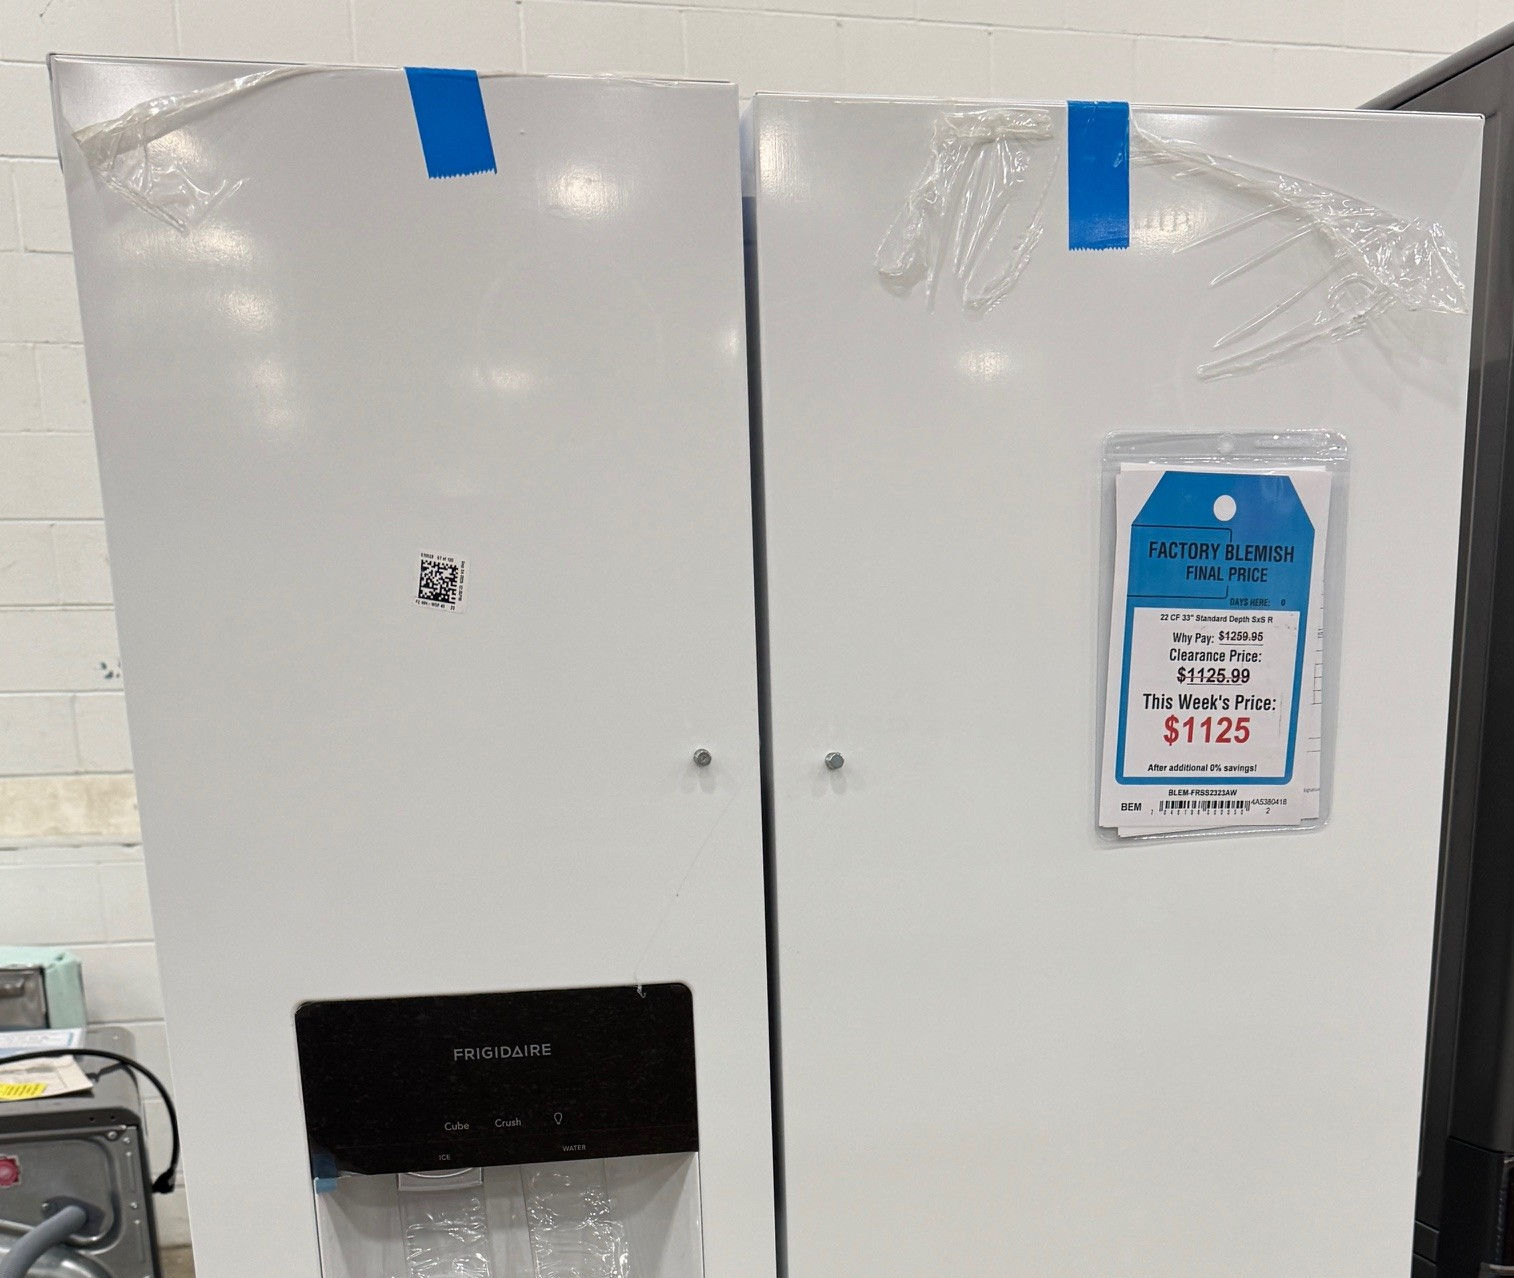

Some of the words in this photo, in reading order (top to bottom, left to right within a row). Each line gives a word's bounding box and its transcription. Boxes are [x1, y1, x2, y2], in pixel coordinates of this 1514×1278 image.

[1149, 541, 1220, 561] FACTORY
[1225, 544, 1294, 562] BLEMISH
[1186, 566, 1224, 581] FINAL
[1228, 567, 1268, 582] PRICE
[1230, 598, 1248, 606] DAYS
[1196, 614, 1227, 623] Standard
[1229, 615, 1249, 624] Depth
[1173, 632, 1192, 644] Why
[1195, 633, 1214, 645] Pay:
[1219, 631, 1263, 642] $1259.95
[1169, 648, 1225, 662] Clearance
[1230, 650, 1262, 662] Price:
[1177, 666, 1250, 684] $1125.99
[1143, 693, 1172, 709] This
[1179, 694, 1230, 710] Week's
[1234, 695, 1276, 711] Price:
[1163, 715, 1250, 746] $1125
[1148, 764, 1167, 772] After
[1169, 764, 1208, 772] additional
[1210, 764, 1222, 772] 0%
[1224, 764, 1257, 774] savings!
[1121, 803, 1142, 811] BEM
[454, 1043, 552, 1062] FRIGIDAIRE
[444, 1121, 469, 1131] Cube
[495, 1117, 522, 1127] Crush
[562, 1144, 586, 1152] WATER
